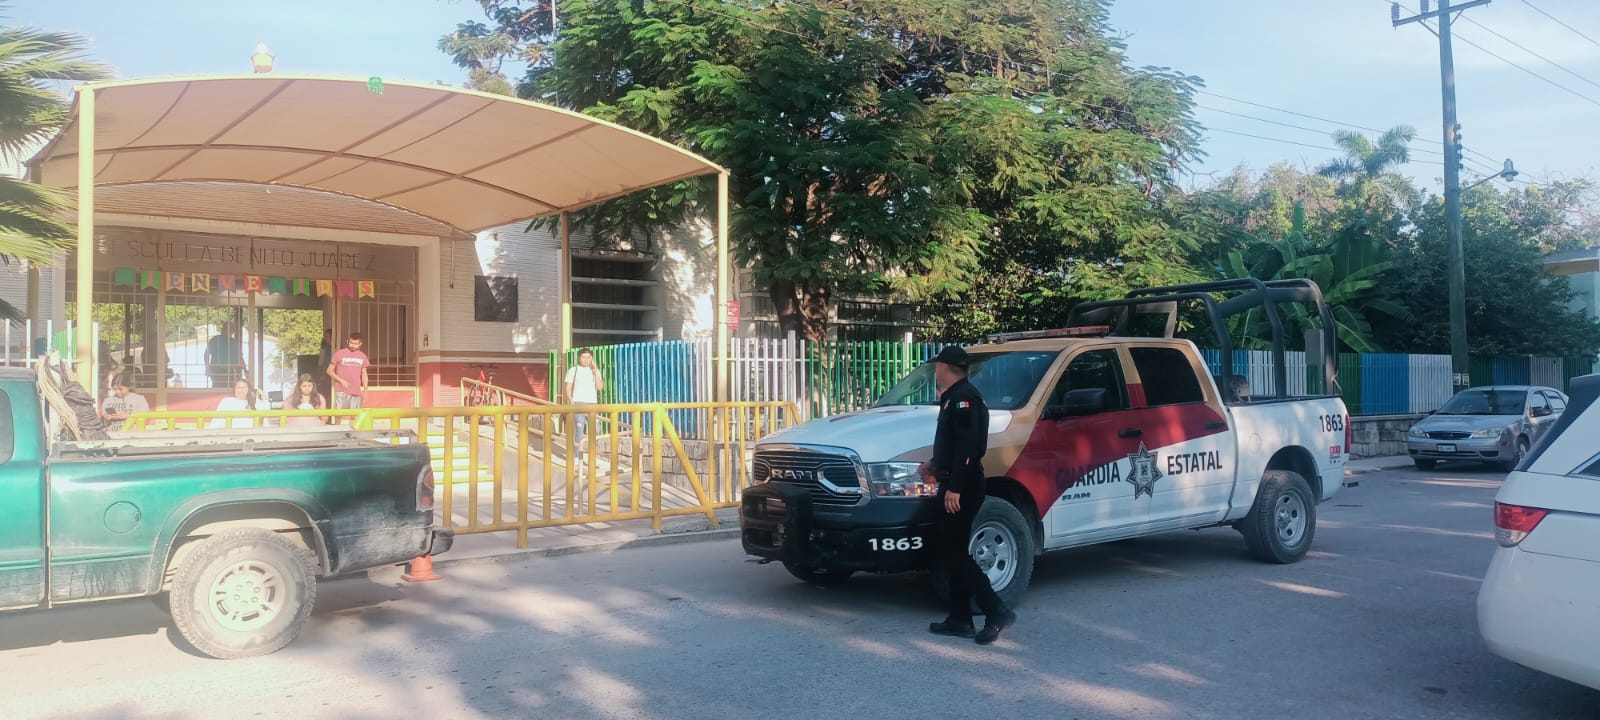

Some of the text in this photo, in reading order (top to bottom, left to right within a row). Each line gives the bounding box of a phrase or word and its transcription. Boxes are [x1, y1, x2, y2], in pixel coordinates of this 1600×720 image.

[301, 250, 376, 271] JUAREZ
[116, 269, 374, 295] IENVEIDS
[1319, 414, 1344, 432] 1863
[771, 468, 815, 480] RAM
[1056, 450, 1223, 489] GUARDIA ESTATAL
[1062, 492, 1091, 501] RAM
[868, 536, 924, 551] 1863
